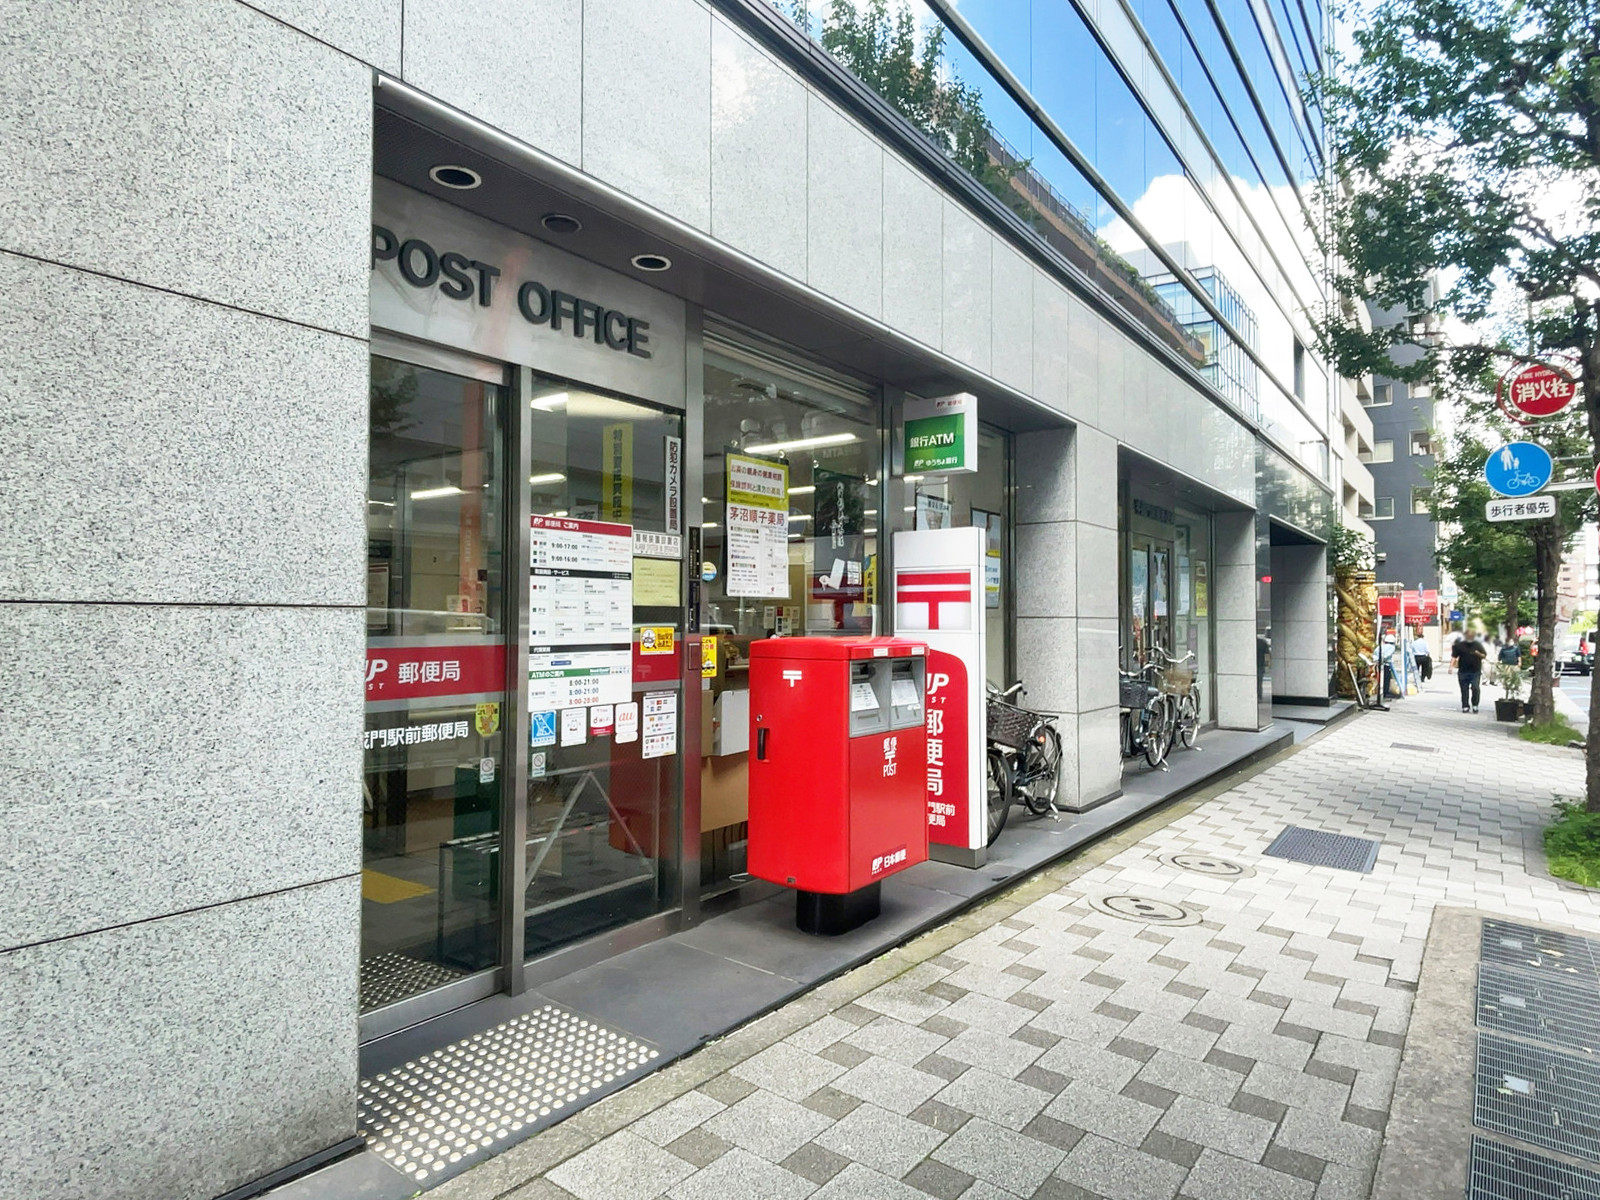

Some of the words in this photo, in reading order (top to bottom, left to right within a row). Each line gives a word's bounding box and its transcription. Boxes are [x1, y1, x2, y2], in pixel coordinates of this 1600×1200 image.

[371, 223, 501, 307] POST
[517, 281, 652, 359] OFFICE
[1519, 372, 1533, 380] FIRE
[910, 432, 955, 448] 銀行ATM
[925, 456, 958, 466] ゆうちょ銀行
[1491, 501, 1551, 518] 歩行者優先
[563, 521, 580, 531] ご案内
[551, 542, 578, 550] 9:00-17:00
[398, 660, 461, 684] 郵便局
[569, 678, 600, 686] 8:00-21:00
[618, 711, 635, 722] au
[883, 736, 898, 753] 郵便
[882, 763, 897, 778] POST
[884, 848, 907, 868] 日本郵便
